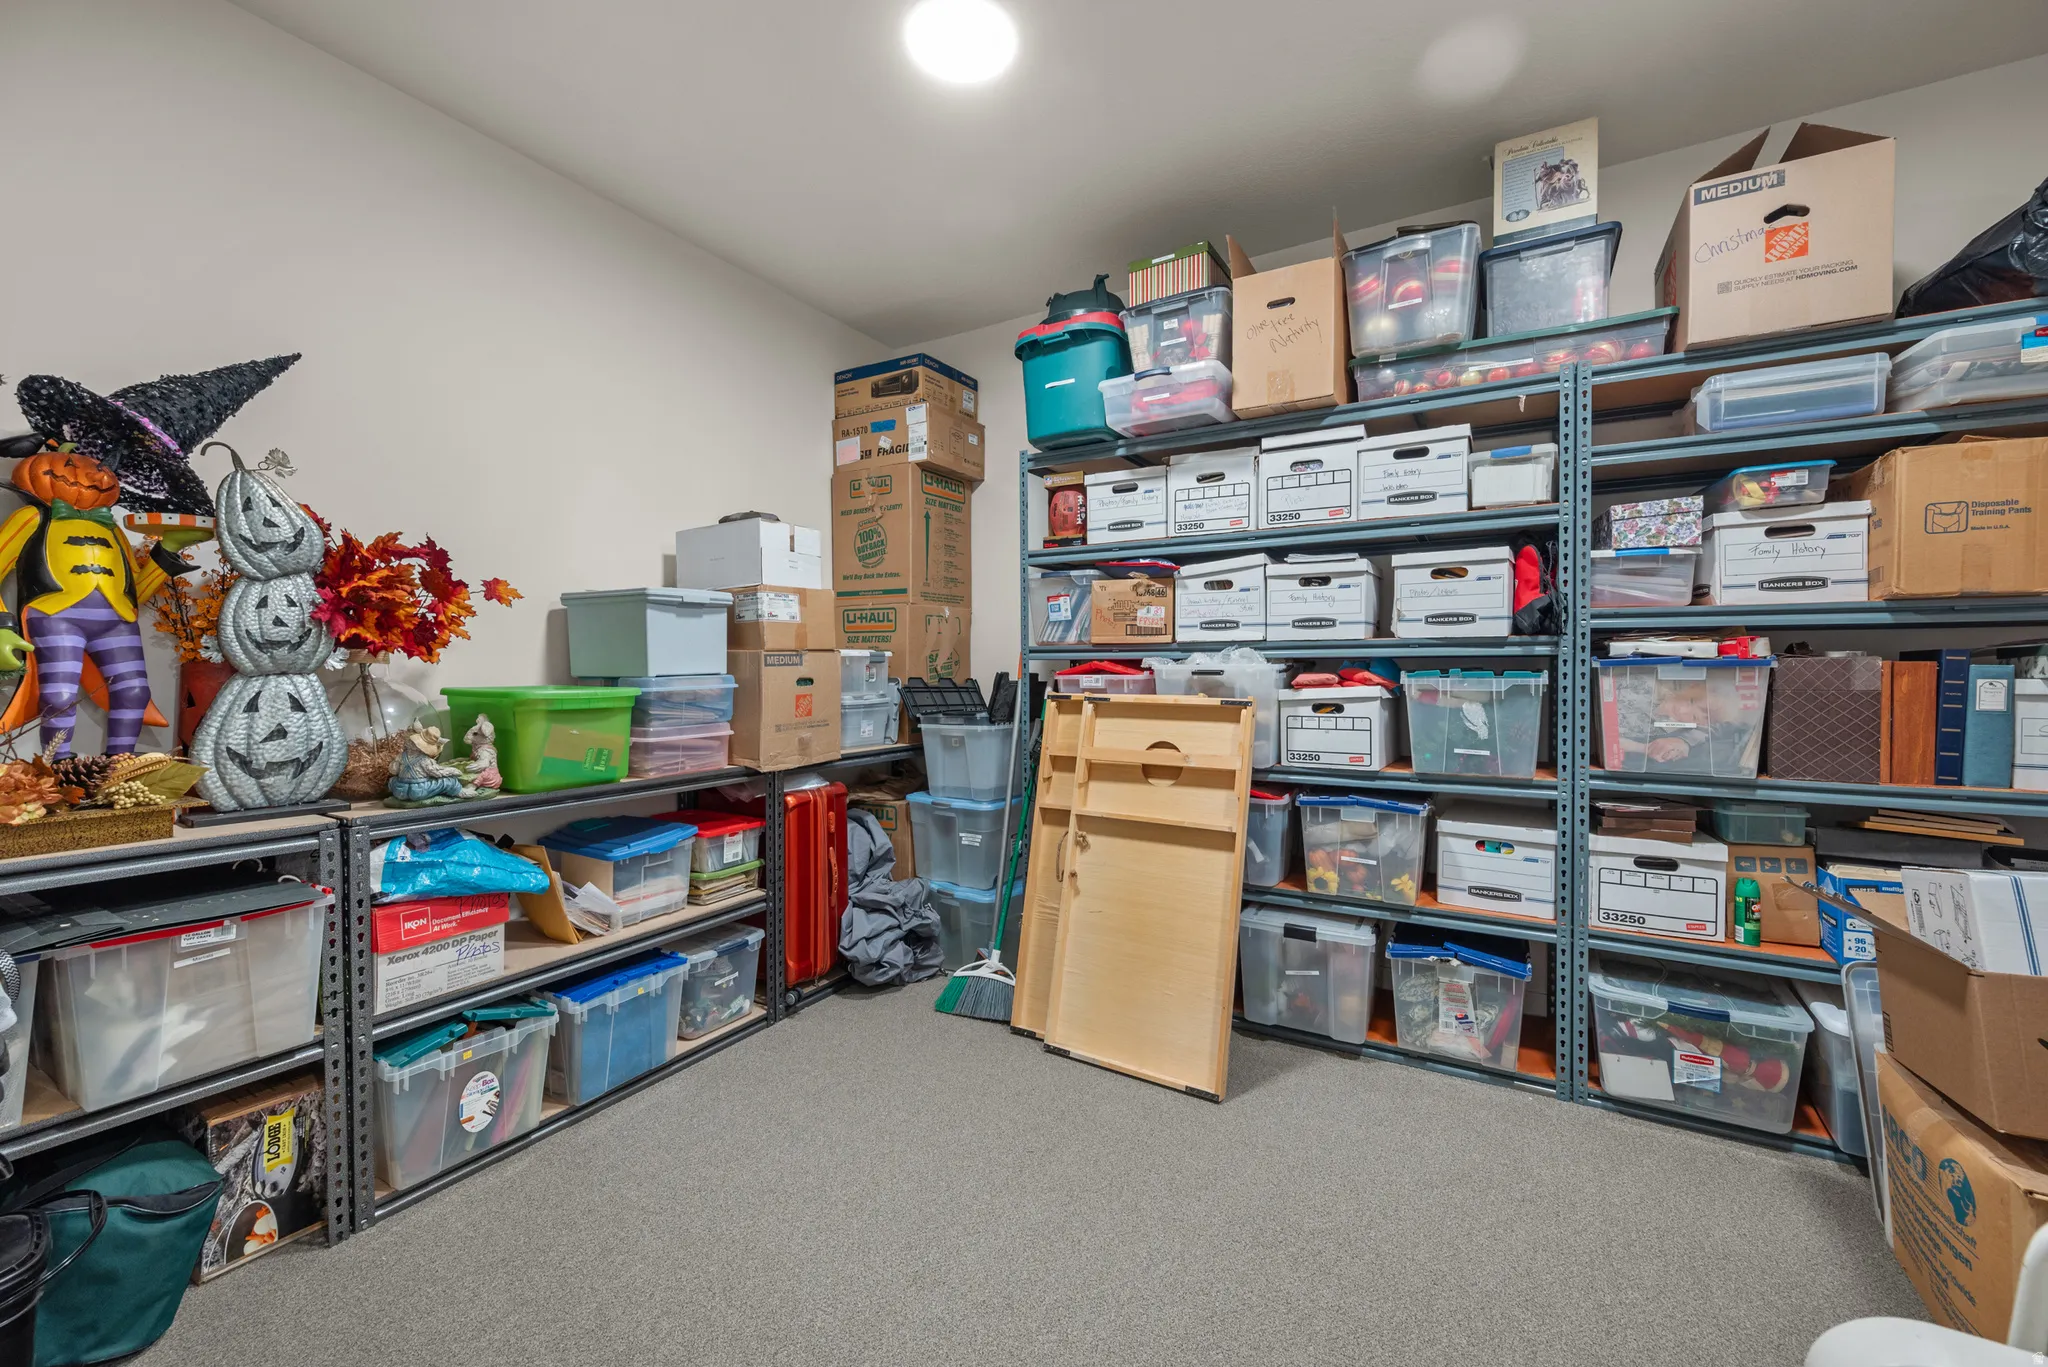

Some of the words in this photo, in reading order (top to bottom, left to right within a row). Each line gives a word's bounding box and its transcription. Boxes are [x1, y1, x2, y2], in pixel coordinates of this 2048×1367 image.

[1701, 171, 1778, 201] MEDIUM
[1695, 224, 1777, 263] Christmas
[1765, 222, 1810, 262] HOME
[1769, 230, 1788, 245] THE
[1782, 235, 1809, 259] DEPOT
[1733, 276, 1763, 286] QUICKLY
[1764, 269, 1797, 280] ESTIMATE
[1798, 265, 1820, 274] YOUR
[1820, 259, 1854, 269] PACKING
[1733, 282, 1760, 292] SUPPLY
[1761, 277, 1785, 286] NEEDS
[1795, 265, 1858, 281] HDMOVING.COM
[924, 358, 939, 369] DENON
[836, 372, 853, 381] DENON
[841, 426, 868, 437] RA-1570
[877, 443, 910, 457] FRAGIL
[924, 473, 963, 495] U-HAUL
[925, 497, 937, 506] SIZE
[938, 500, 963, 513] MATTERS!
[1971, 498, 2020, 508] Disposable
[840, 508, 853, 516] NEED
[1269, 512, 1301, 522] 33250
[1971, 508, 2006, 517] Training
[2008, 506, 2032, 515] Pants
[1176, 522, 1205, 531] 33250
[858, 527, 882, 544] 100%
[857, 539, 885, 555] BUY-BACK
[1748, 542, 1781, 564] Family
[1791, 542, 1826, 560] History
[846, 611, 893, 624] U-HAUL
[847, 635, 860, 643] SIZE
[861, 635, 892, 643] MATTERS!
[766, 655, 800, 665] MEDIUM
[1289, 752, 1320, 761] 33250
[1470, 888, 1503, 897] BANKERS
[432, 913, 462, 926] Document
[462, 907, 489, 918] Efficiency
[1602, 911, 1646, 925] 33250
[404, 917, 427, 930] IKON
[433, 924, 440, 932] At
[1854, 937, 1867, 945] 96
[387, 951, 420, 966] Xerox
[421, 942, 450, 956] 4200
[451, 936, 467, 948] DP
[468, 930, 498, 944] Paper
[1854, 945, 1867, 953] 20
[267, 1122, 282, 1163] LODGE
